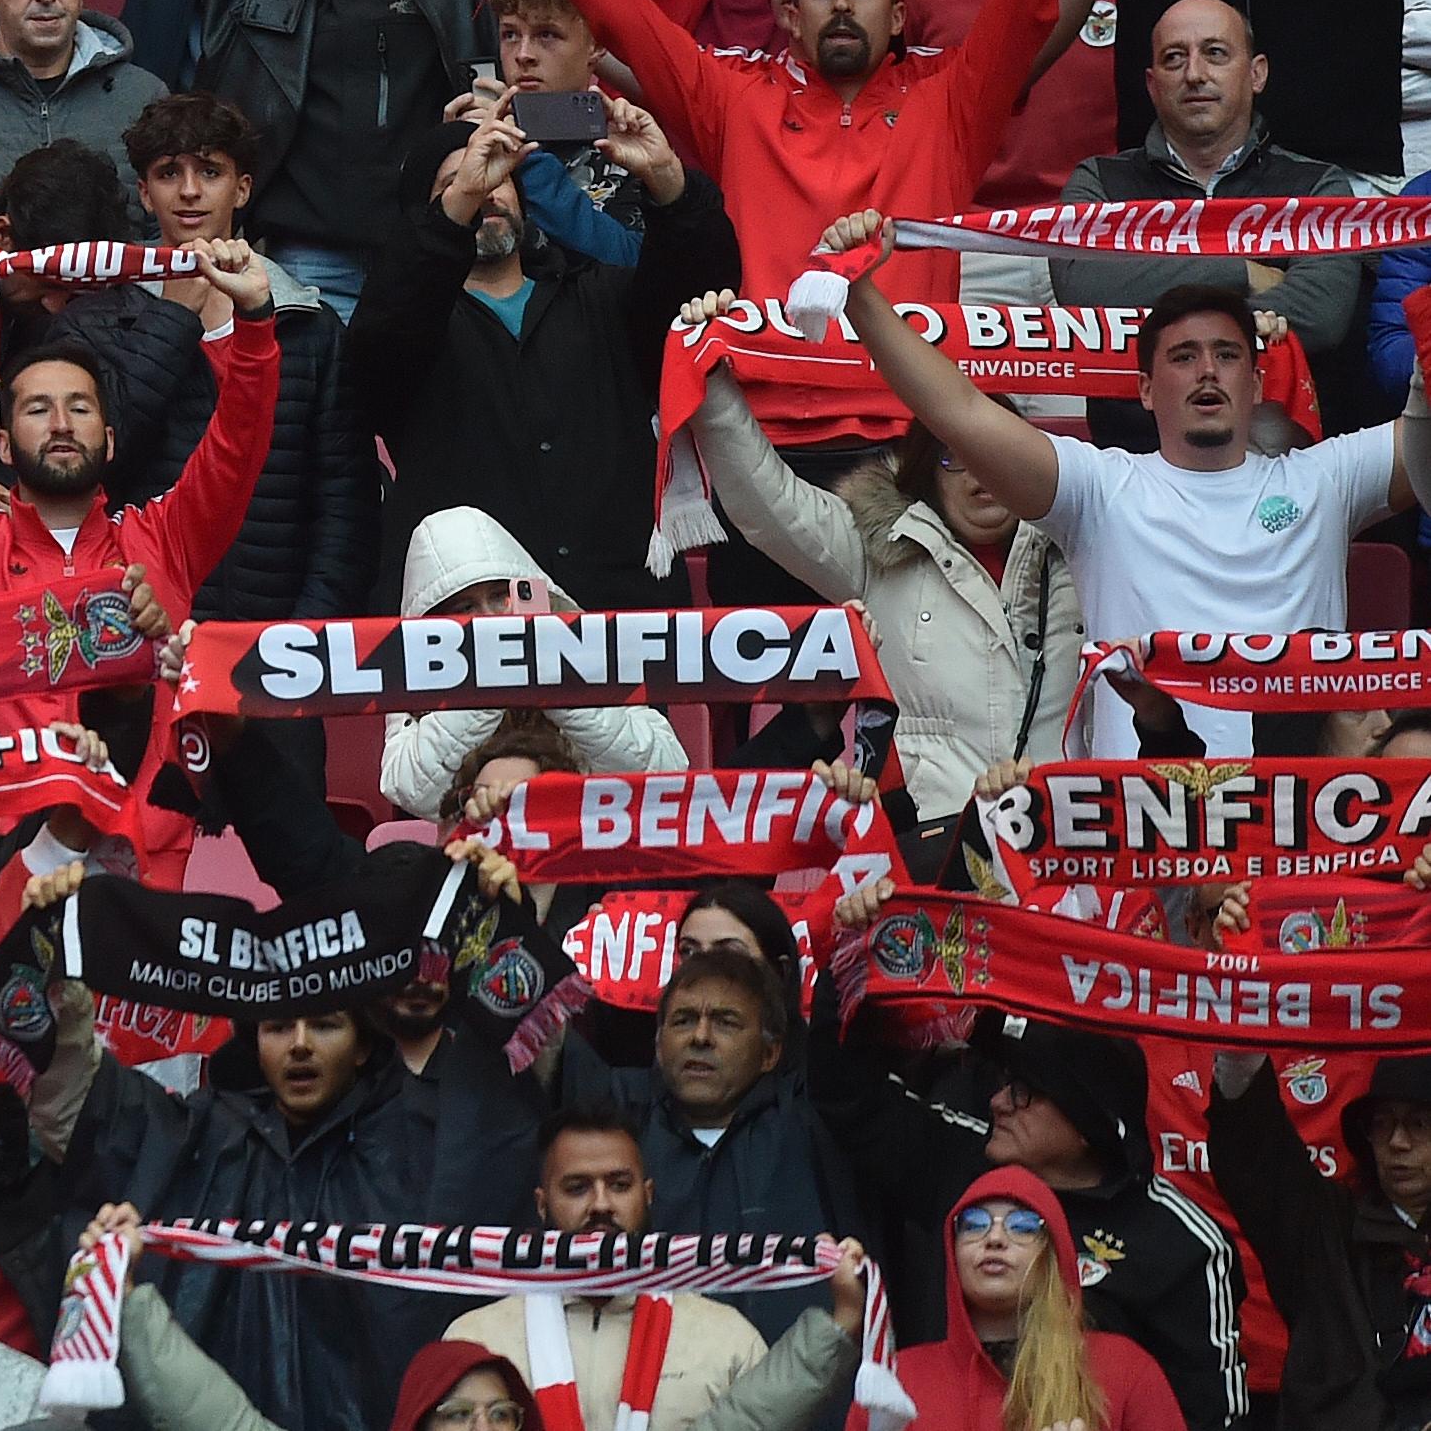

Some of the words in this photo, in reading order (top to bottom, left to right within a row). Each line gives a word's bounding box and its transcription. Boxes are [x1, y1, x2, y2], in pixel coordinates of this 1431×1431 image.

[960, 305, 1153, 352] BENF
[257, 623, 386, 702] SL
[401, 608, 861, 692] BENFICA
[1209, 676, 1259, 695] ISSO
[1264, 676, 1296, 695] ME
[1300, 672, 1424, 695] ENVAIDECE
[1028, 856, 1116, 880] SPORT
[1131, 853, 1232, 881] LISBOA
[1246, 855, 1263, 877] E
[1276, 844, 1401, 878] BENFICA
[179, 915, 221, 965] SL
[1204, 952, 1260, 973] 1904
[128, 959, 202, 992] MAIOR
[207, 974, 283, 1004] CLUBE
[288, 972, 324, 999] DO
[329, 947, 414, 991] MUNDO
[1060, 953, 1311, 1029] BENFICA
[1330, 983, 1405, 1030] SL
